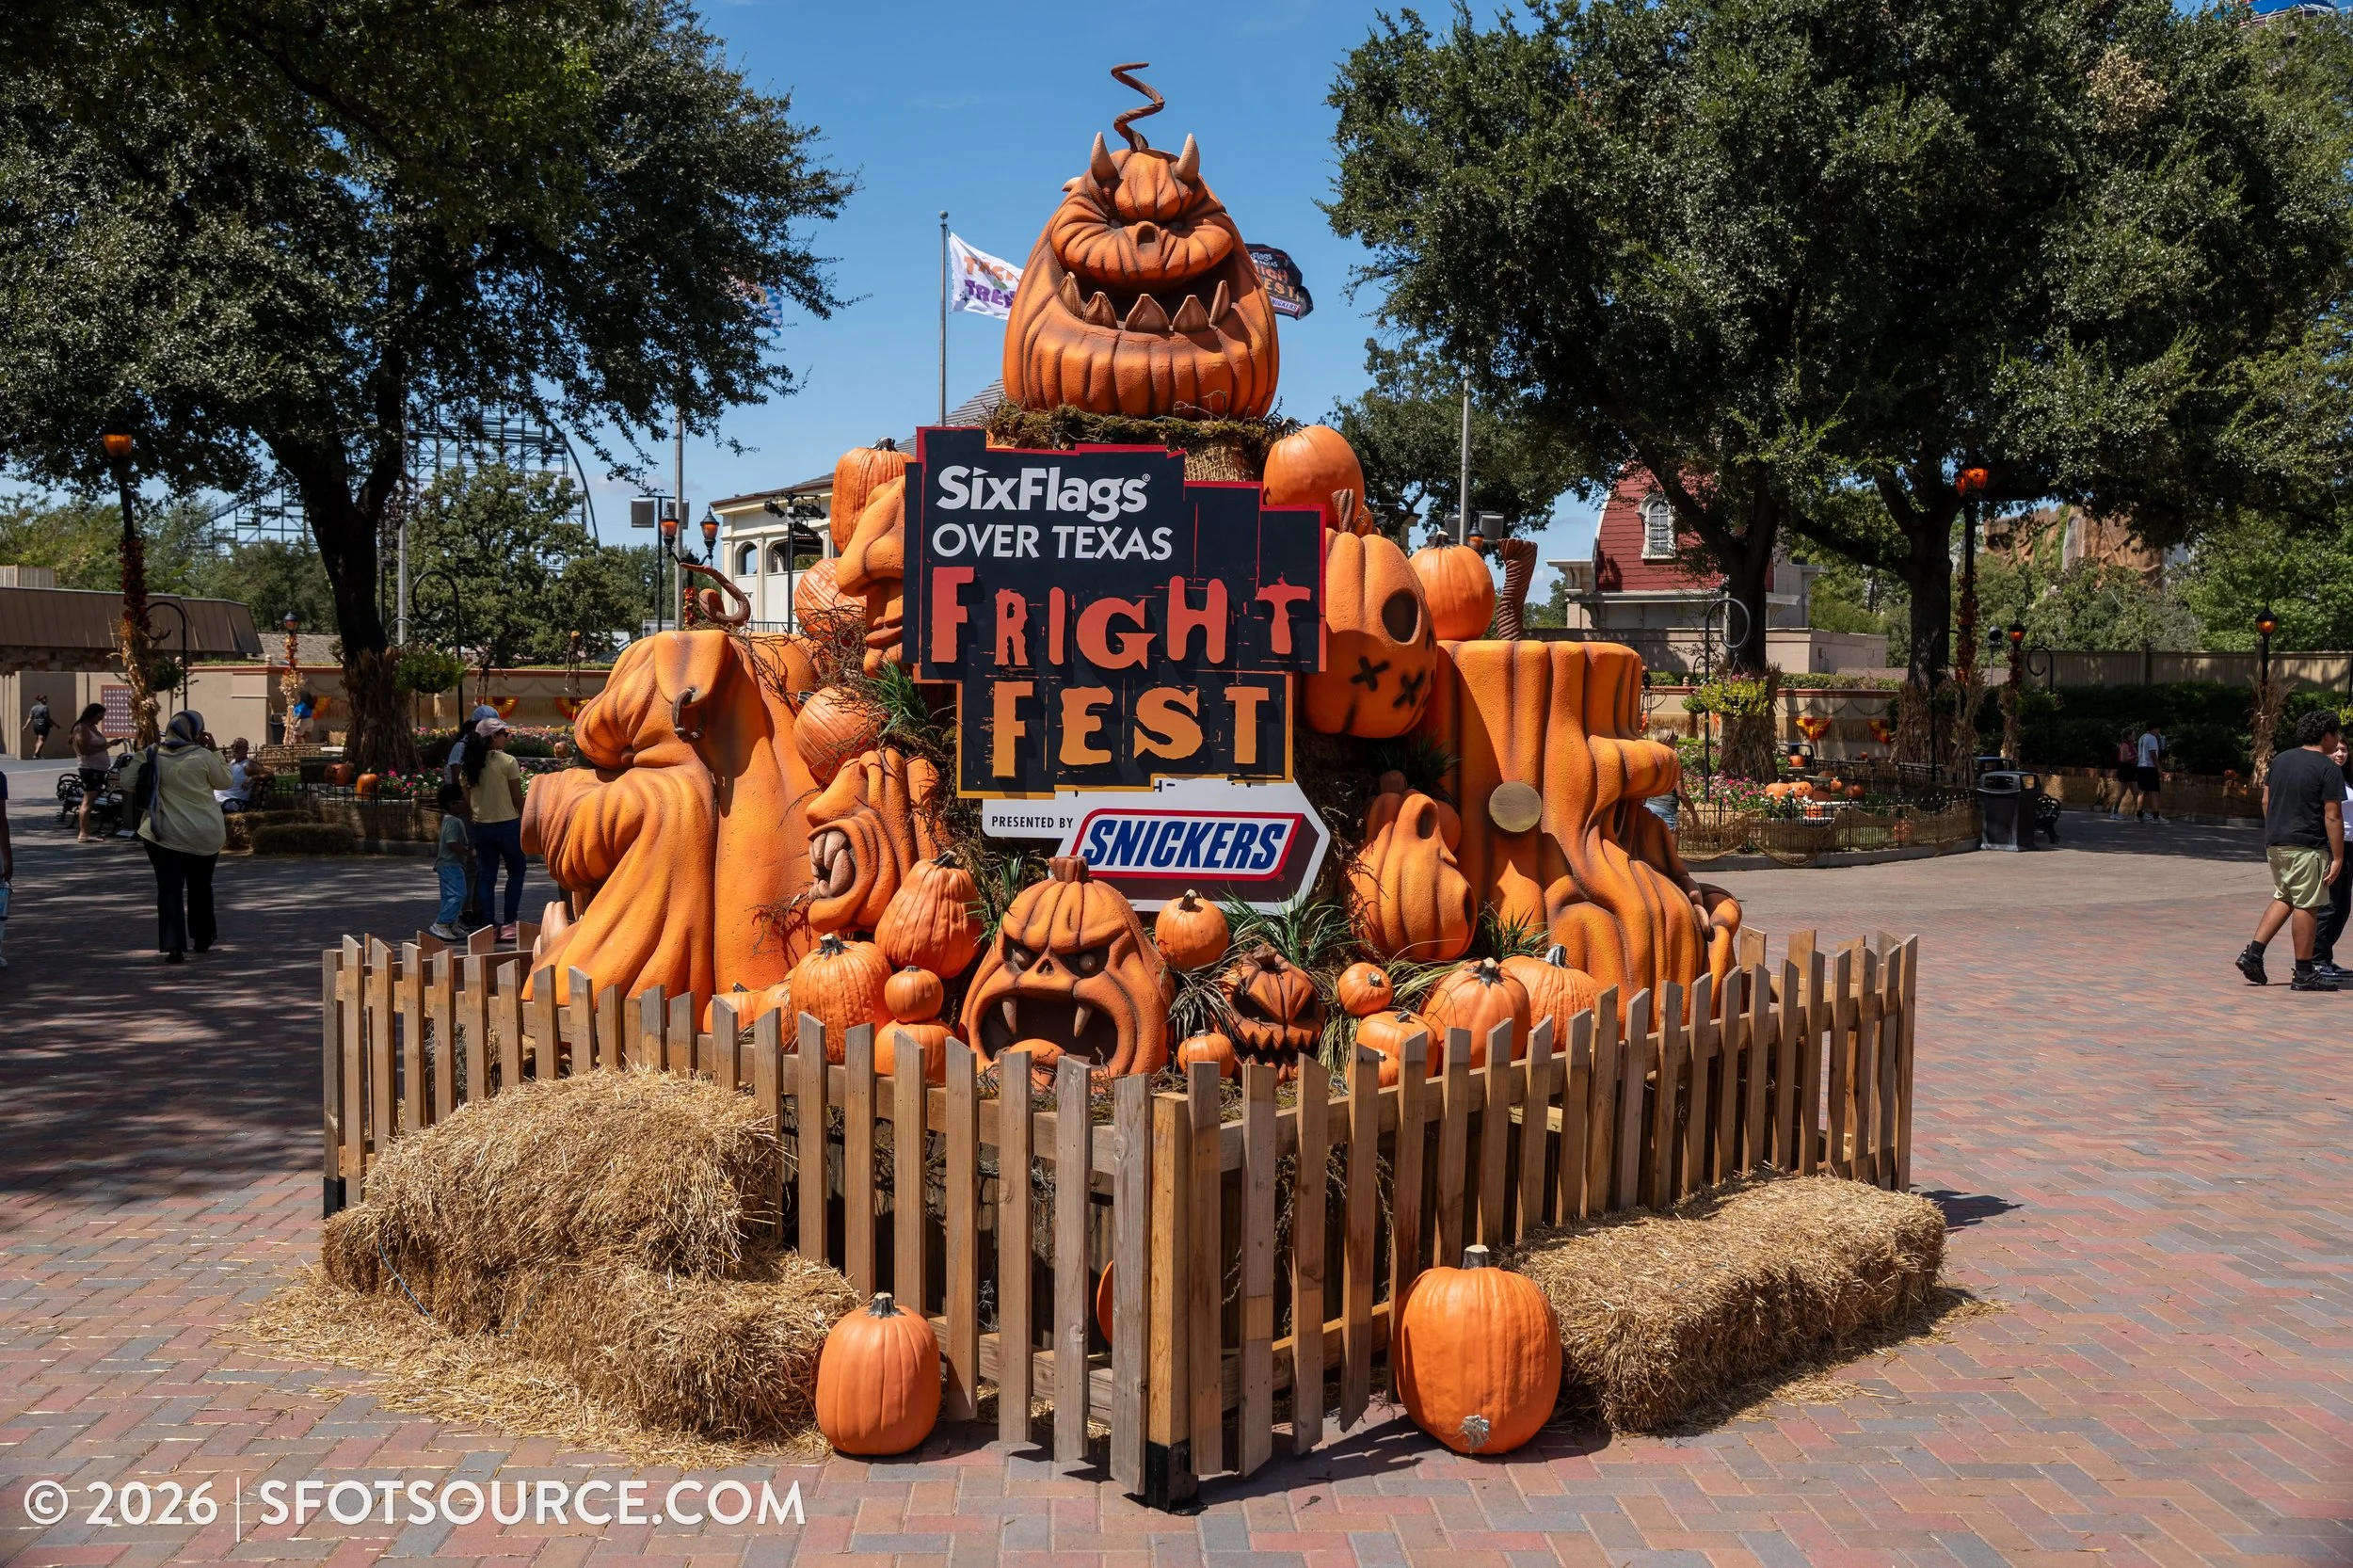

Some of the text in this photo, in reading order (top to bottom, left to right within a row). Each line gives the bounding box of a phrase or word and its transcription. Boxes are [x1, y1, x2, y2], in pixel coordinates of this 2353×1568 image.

[932, 523, 1174, 560] OVER TEXAS
[931, 567, 1311, 669] FRIGHT
[991, 681, 1270, 777] FEST
[991, 815, 1074, 828] PRESENTED BY
[1082, 819, 1288, 870] SNICKERS
